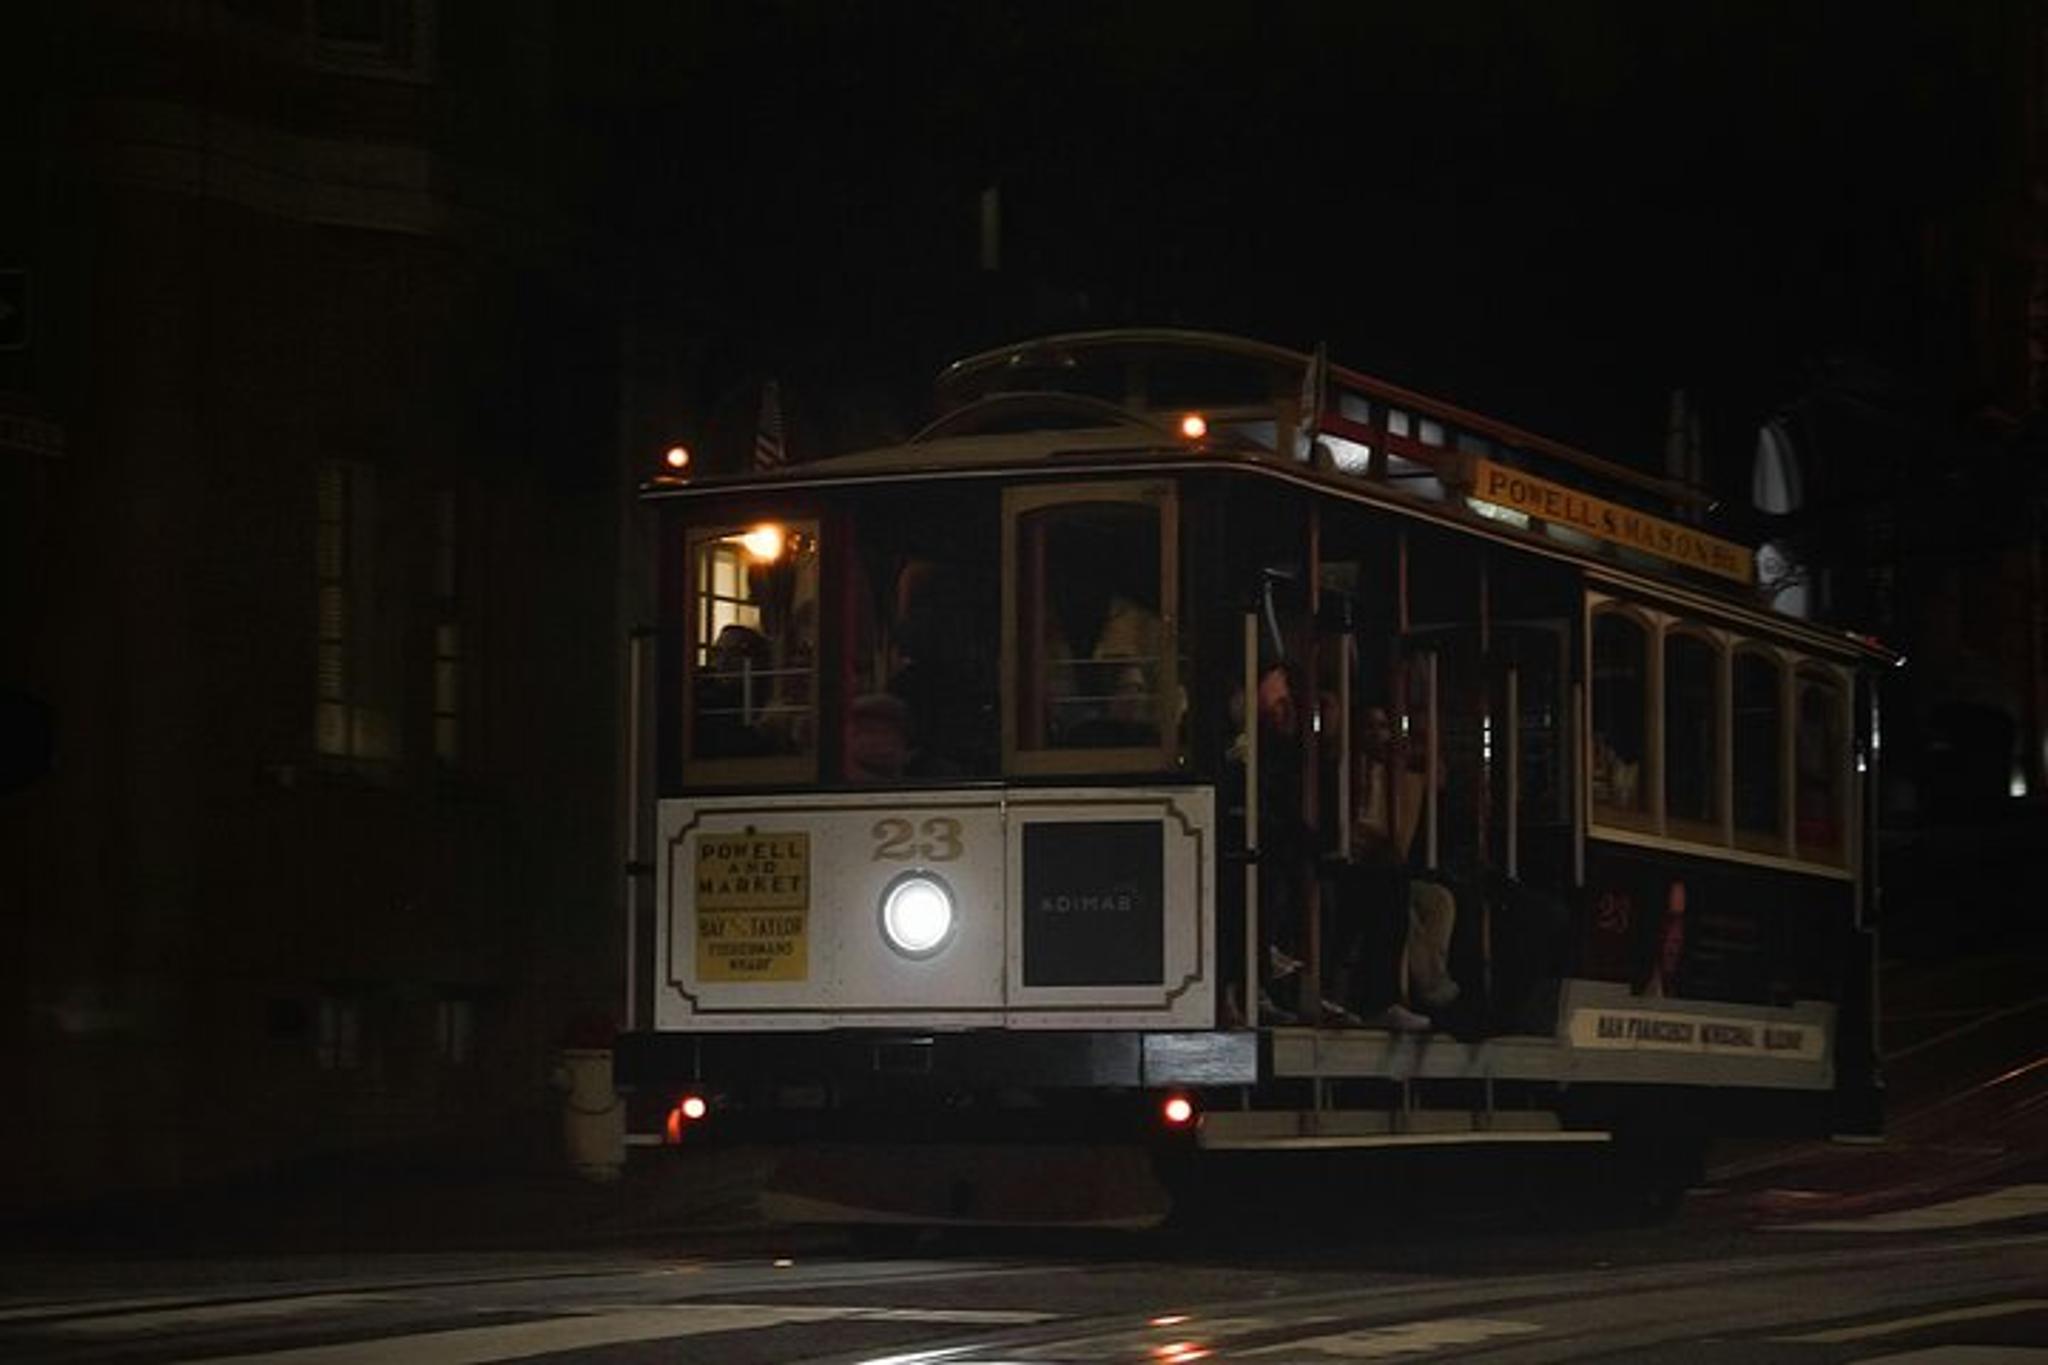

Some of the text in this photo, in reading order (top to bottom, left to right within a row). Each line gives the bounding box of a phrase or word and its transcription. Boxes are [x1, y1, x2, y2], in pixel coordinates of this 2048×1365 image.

[870, 817, 964, 863] 23
[701, 840, 802, 861] POWELL
[727, 861, 777, 875] AND
[698, 874, 802, 894] MARKET
